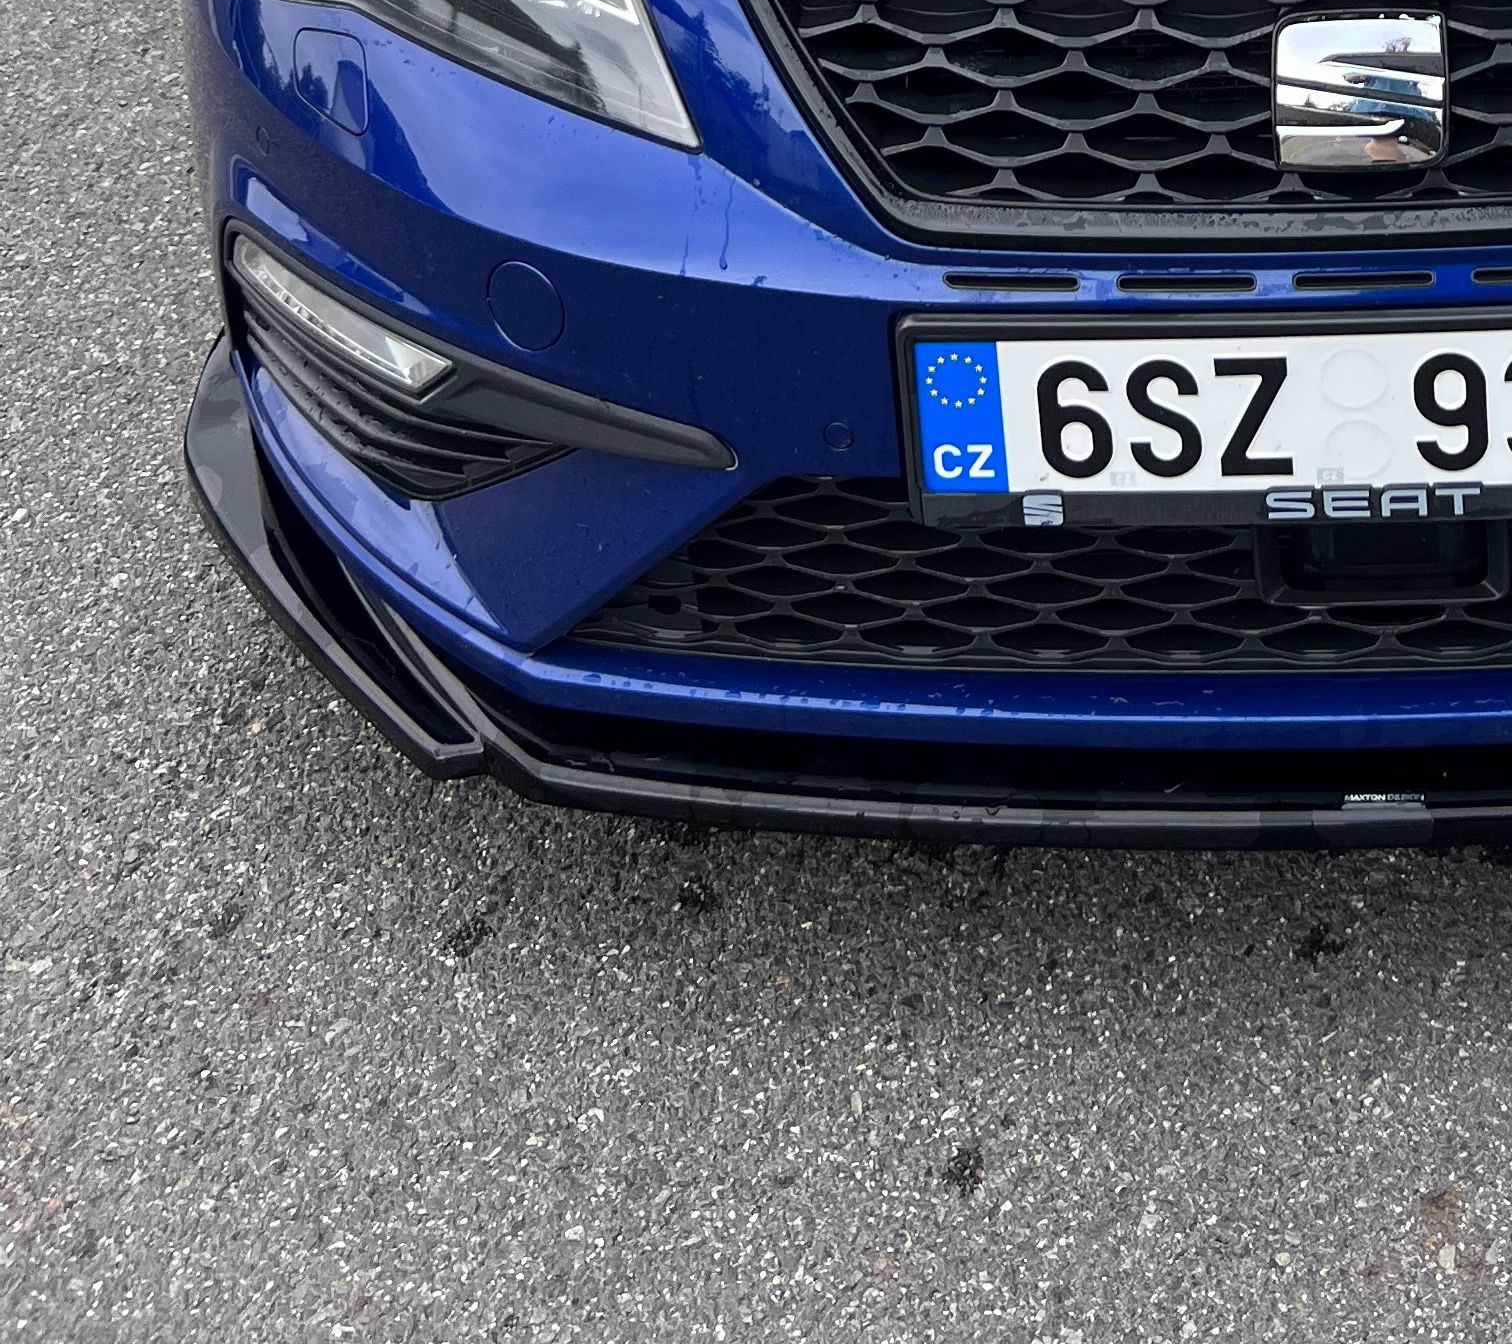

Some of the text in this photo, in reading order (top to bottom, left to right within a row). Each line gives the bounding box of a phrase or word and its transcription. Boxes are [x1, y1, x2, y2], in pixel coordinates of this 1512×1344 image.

[1036, 355, 1295, 479] 6SZ
[933, 443, 996, 479] CZ
[1265, 486, 1482, 520] SEAT
[1344, 793, 1386, 802] MAXTON
